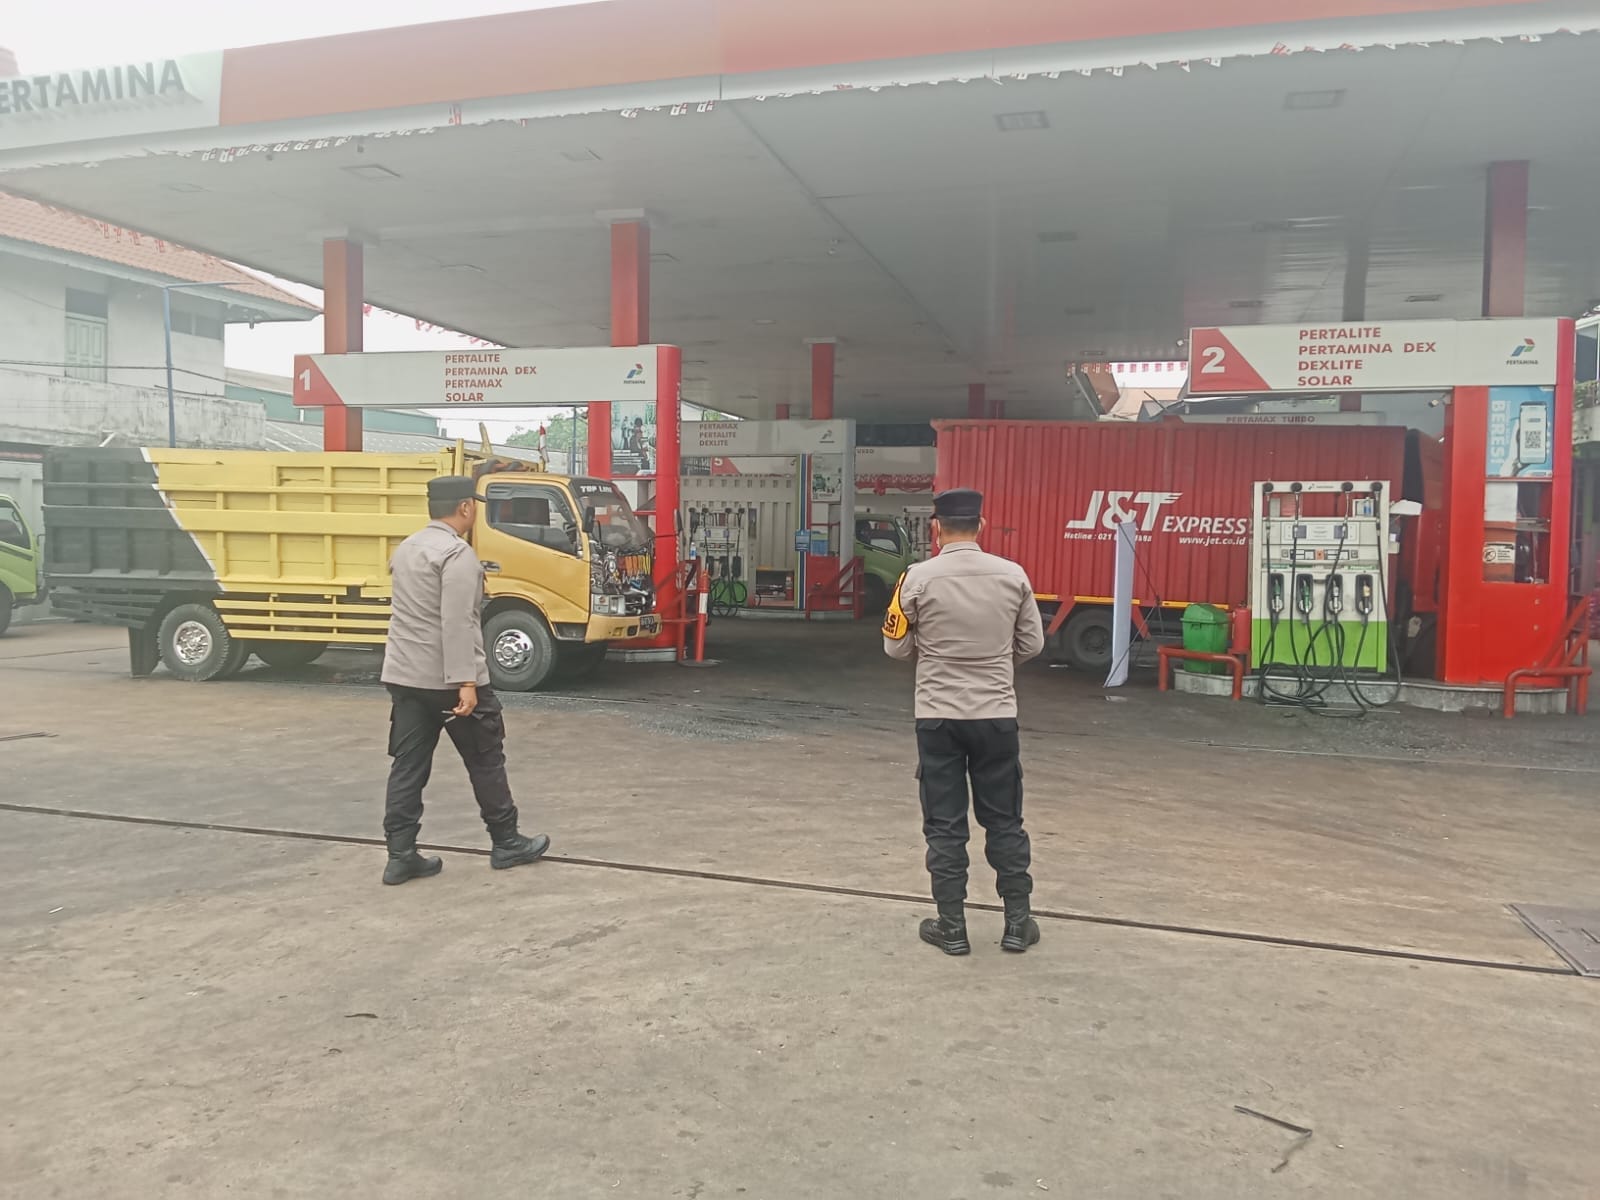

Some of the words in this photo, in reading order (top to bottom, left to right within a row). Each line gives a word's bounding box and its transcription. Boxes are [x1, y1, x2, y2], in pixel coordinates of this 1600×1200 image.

[0, 59, 185, 113] ERTAMINA
[1300, 327, 1381, 340] PERTALITE
[1299, 343, 1393, 355] PERTAMINA
[1403, 342, 1436, 353] DEX
[445, 353, 501, 363] PERTALITE
[1201, 346, 1225, 373] 2
[445, 367, 508, 376] PERTAMINA
[515, 366, 537, 375] DEX
[1298, 359, 1363, 371] DEXLITE
[299, 368, 311, 391] 1
[445, 379, 502, 388] PERTAMAX
[1297, 375, 1353, 386] SOLAR
[445, 392, 484, 402] SOLAR
[1226, 415, 1277, 424] PERTAMAX
[699, 431, 737, 439] PERTALITE
[1490, 400, 1506, 464] BERES!
[1066, 490, 1184, 532] J&T
[1162, 515, 1248, 535] EXPRESS
[1179, 535, 1246, 546] www.jet.co.id
